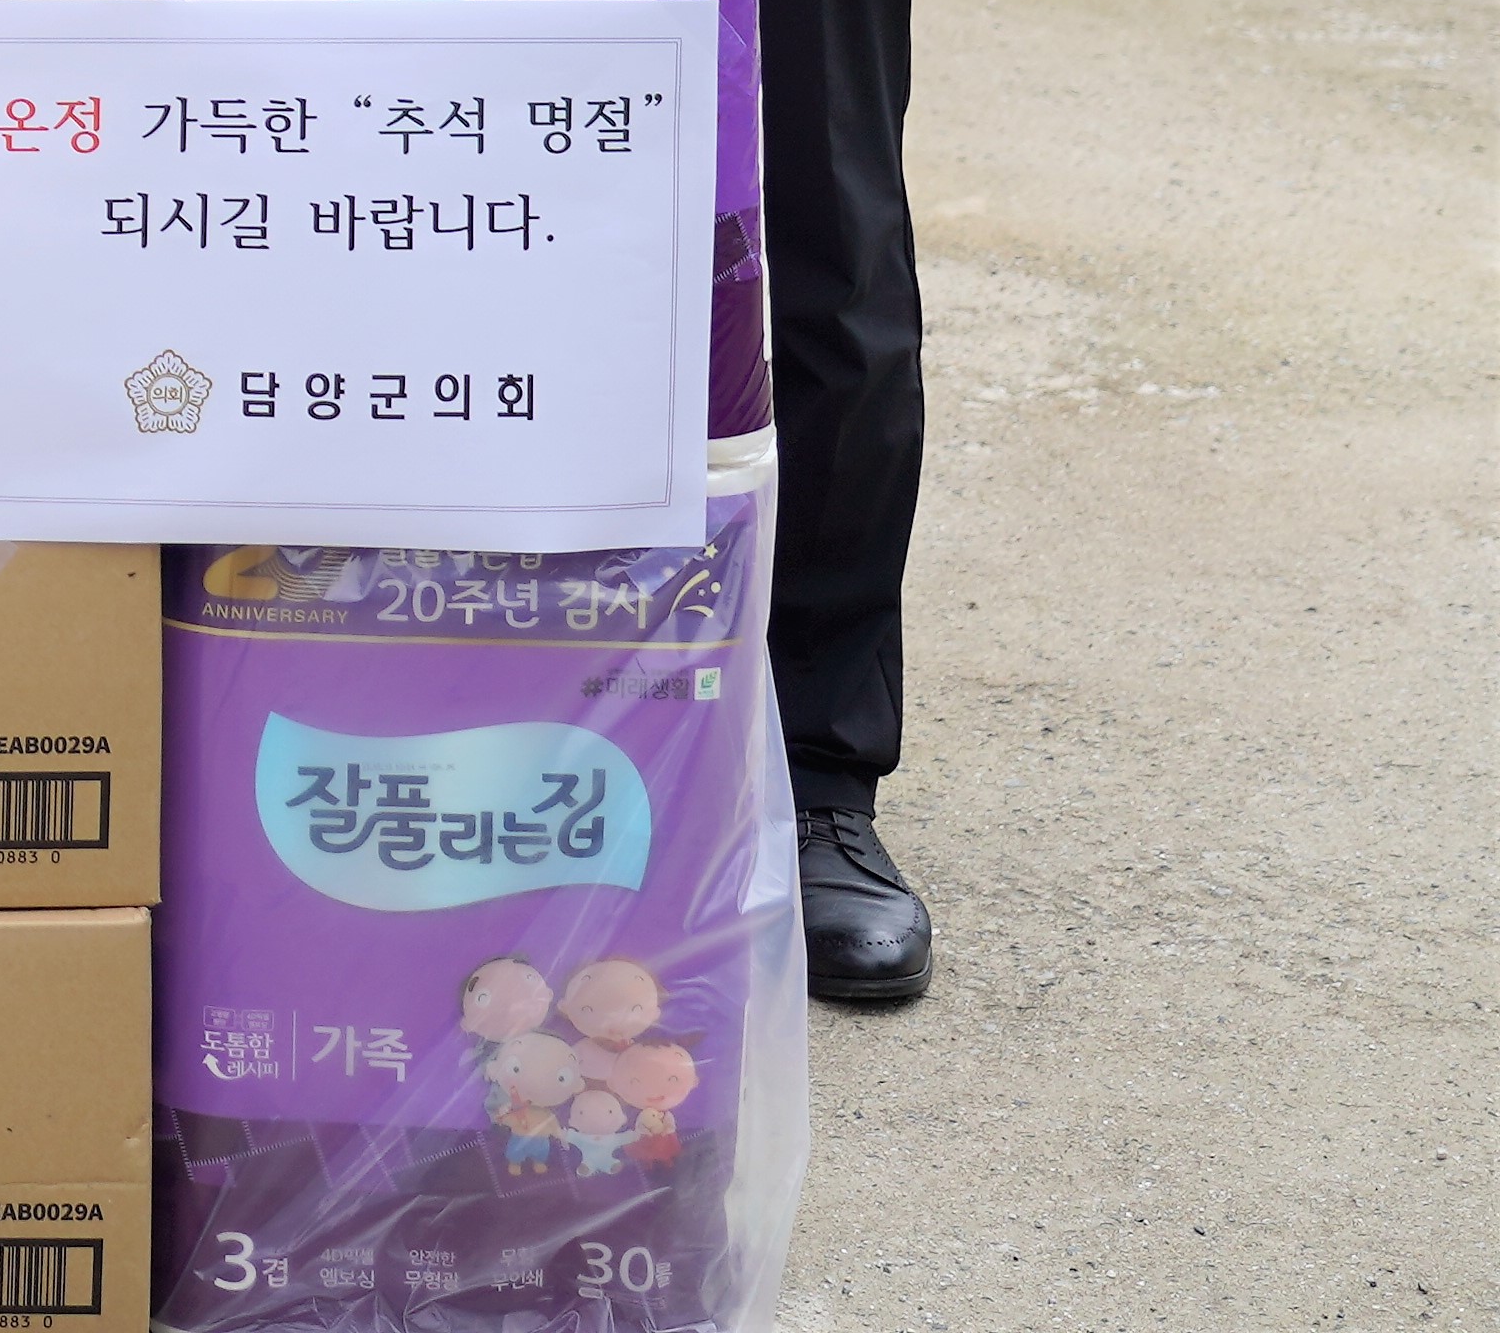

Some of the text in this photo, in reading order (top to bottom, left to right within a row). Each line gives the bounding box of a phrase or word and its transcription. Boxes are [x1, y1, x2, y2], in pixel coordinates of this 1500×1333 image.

[143, 97, 317, 153] 가득한
[102, 193, 553, 251] 되시길 바랍니다.
[202, 604, 349, 626] ANNIVERSARY
[376, 579, 654, 631] 20주년 감사
[286, 763, 606, 869] 잘풀리는집
[201, 1030, 273, 1059] 도톰함
[311, 1025, 413, 1082] 가족
